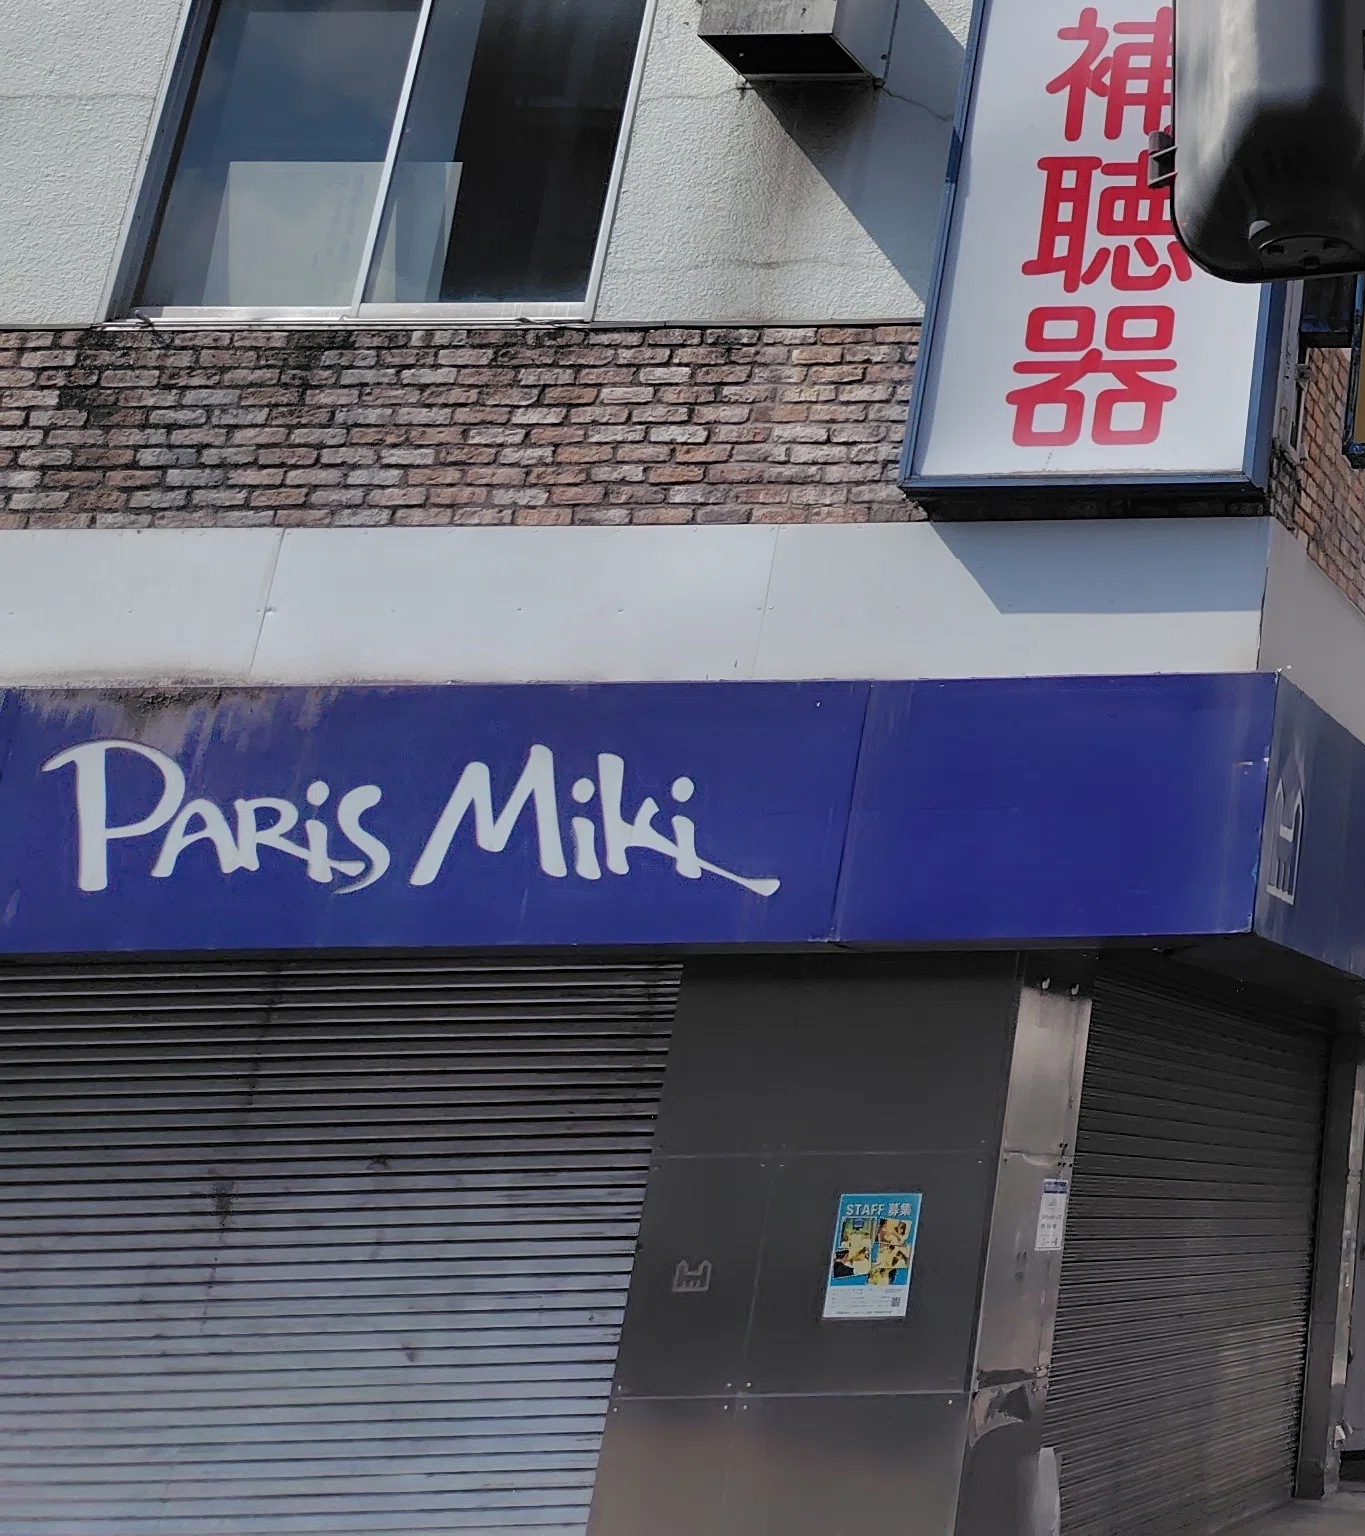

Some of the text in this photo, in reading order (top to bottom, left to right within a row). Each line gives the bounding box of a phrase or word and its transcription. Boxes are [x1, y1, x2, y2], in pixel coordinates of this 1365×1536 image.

[1004, 6, 1194, 448] 補聴器
[845, 1203, 886, 1216] STAFF
